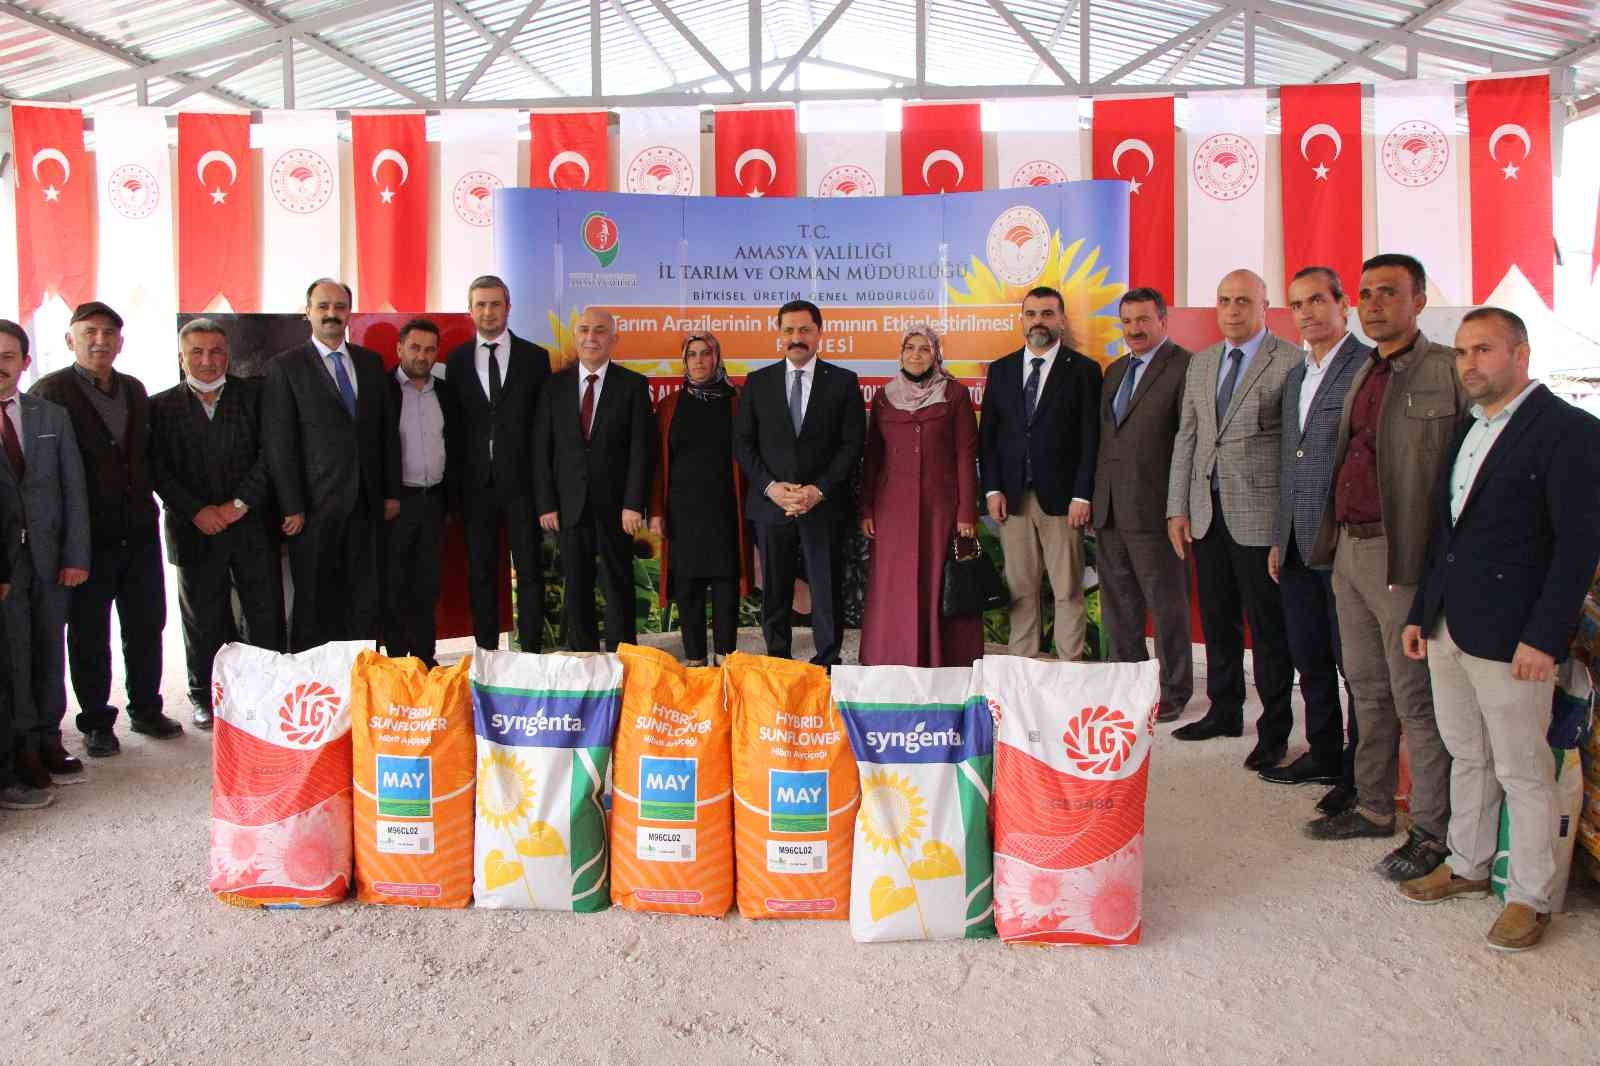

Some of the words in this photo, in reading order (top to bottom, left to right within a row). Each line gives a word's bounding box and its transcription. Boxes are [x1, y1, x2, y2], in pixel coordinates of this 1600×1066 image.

[798, 225, 830, 239] T.C.
[735, 245, 808, 260] AMASYA
[815, 242, 892, 260] VALİLİĞİ
[657, 262, 676, 279] İL
[680, 264, 738, 280] TARIM
[769, 266, 840, 280] ORMAN
[847, 263, 967, 281] MÜDÜRLÜĞÜ
[692, 288, 745, 301] BİTKİSEL
[754, 289, 801, 301] ÜRETİM
[856, 289, 935, 302] MÜDÜRLÜĞÜ
[611, 315, 657, 332] Tarım
[662, 314, 762, 332] Arazilerinin
[298, 700, 325, 727] LG
[776, 711, 824, 729] HYBRID
[760, 726, 841, 746] SUNFLOWER
[1087, 726, 1116, 755] LG
[383, 771, 425, 789] MAY
[646, 772, 691, 791] MAY
[776, 787, 822, 804] MAY
[387, 826, 419, 835] M96CL02
[648, 832, 681, 842] M96CL02
[778, 846, 813, 855] M96CL02
